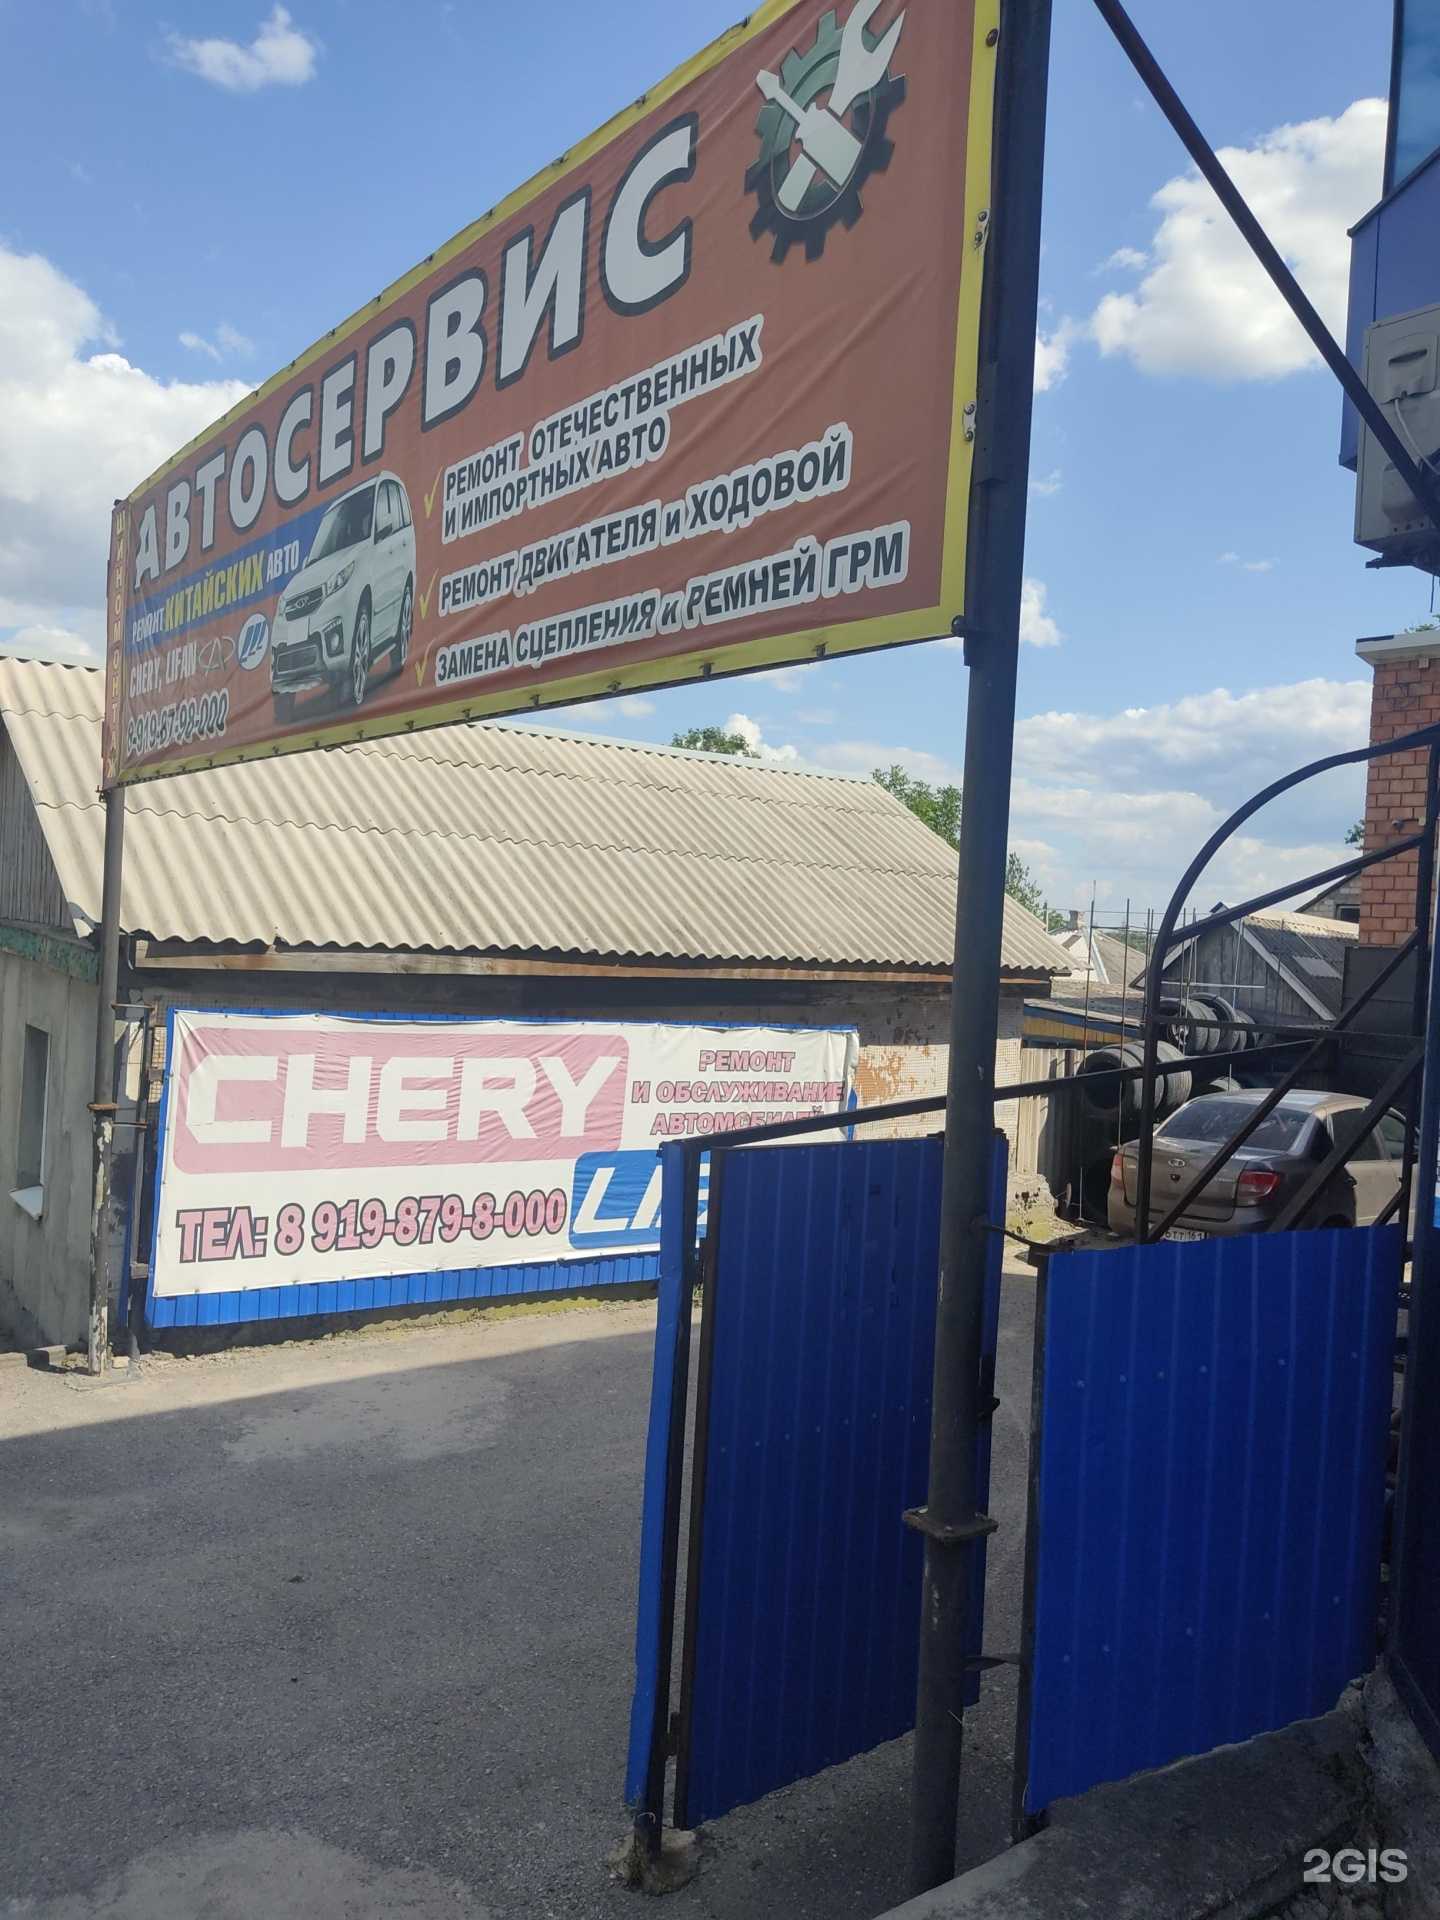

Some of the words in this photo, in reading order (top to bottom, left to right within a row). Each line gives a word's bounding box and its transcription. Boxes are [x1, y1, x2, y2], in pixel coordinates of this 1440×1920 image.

[134, 112, 699, 589] АВТОСЕРВИС
[446, 437, 521, 502] РЕМОНТ
[530, 323, 759, 463] ОТЕЧЕСТВЕННЫХ
[440, 559, 516, 611] РЕМОНТ
[517, 507, 658, 592] ДВИГАТЕЛЯ
[688, 431, 847, 534] ХОДОВОЙ
[444, 509, 457, 538] И
[460, 448, 591, 530] ИМПОРТНЫХ
[596, 416, 667, 475] АВТО
[131, 607, 165, 645] РЕМОНТ
[165, 549, 265, 632] КИТАЙСКИХ
[266, 539, 300, 584] АВТО
[437, 630, 510, 683] ЗАМЕНА
[515, 597, 657, 667] СЦЕПЛЕНИЯ
[686, 544, 817, 618] РЕМНЕЙ
[827, 531, 904, 589] ГРМ
[165, 640, 198, 685] LIFAN
[184, 1052, 625, 1149] CHERY
[631, 1080, 651, 1104] И
[655, 1080, 846, 1104] ОБСЛУЖИВАНИЕ
[698, 1049, 796, 1073] РЕМОНТ
[176, 1205, 269, 1263] ТЕЛ:
[275, 1203, 305, 1255] 8
[311, 1187, 568, 1250] 919-879-8-000
